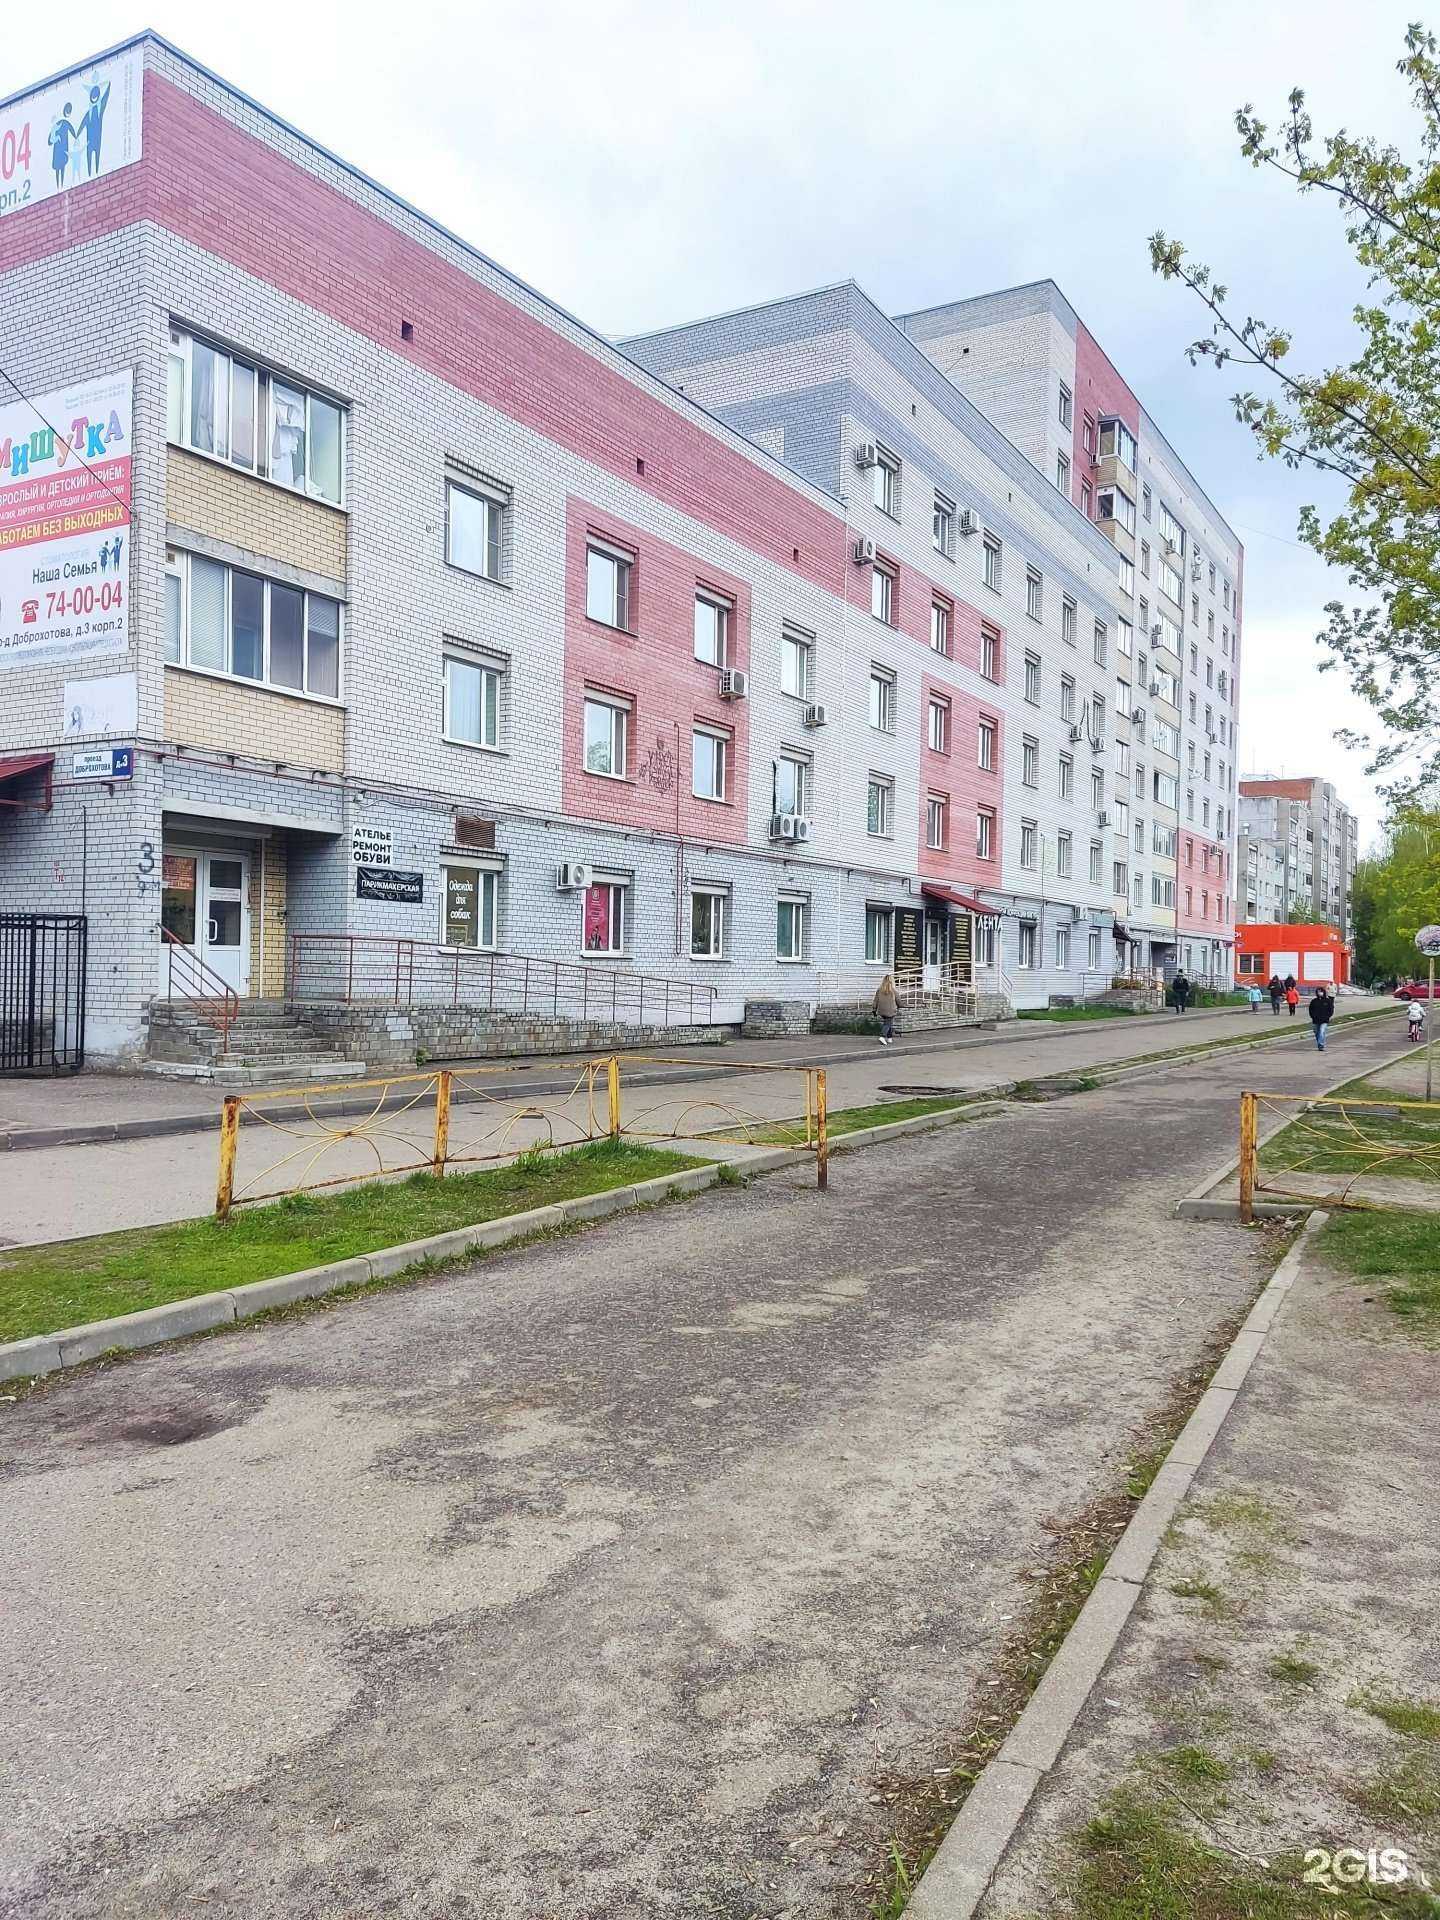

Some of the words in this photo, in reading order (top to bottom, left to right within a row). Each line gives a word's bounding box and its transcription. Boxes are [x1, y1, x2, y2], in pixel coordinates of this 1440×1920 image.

[48, 470, 89, 498] ДЕТСКИЙ
[42, 518, 61, 536] БЕЗ
[63, 505, 124, 532] ВЫХОДНЫХ
[33, 567, 59, 584] Наша
[63, 561, 97, 579] Семья
[46, 580, 122, 619] 74-00-04
[12, 627, 73, 647] Доброхотова,
[76, 622, 89, 637] д.3
[92, 617, 123, 635] корп.2
[354, 828, 392, 841] АТЕЛЬЕ
[353, 840, 392, 854] РЕМОНТ
[353, 852, 391, 865] ОБУВИ
[361, 879, 420, 893] ПАРИКМАХЕРСКАЯ
[449, 879, 474, 892] Одежда
[455, 893, 467, 905] для
[450, 908, 471, 920] собак
